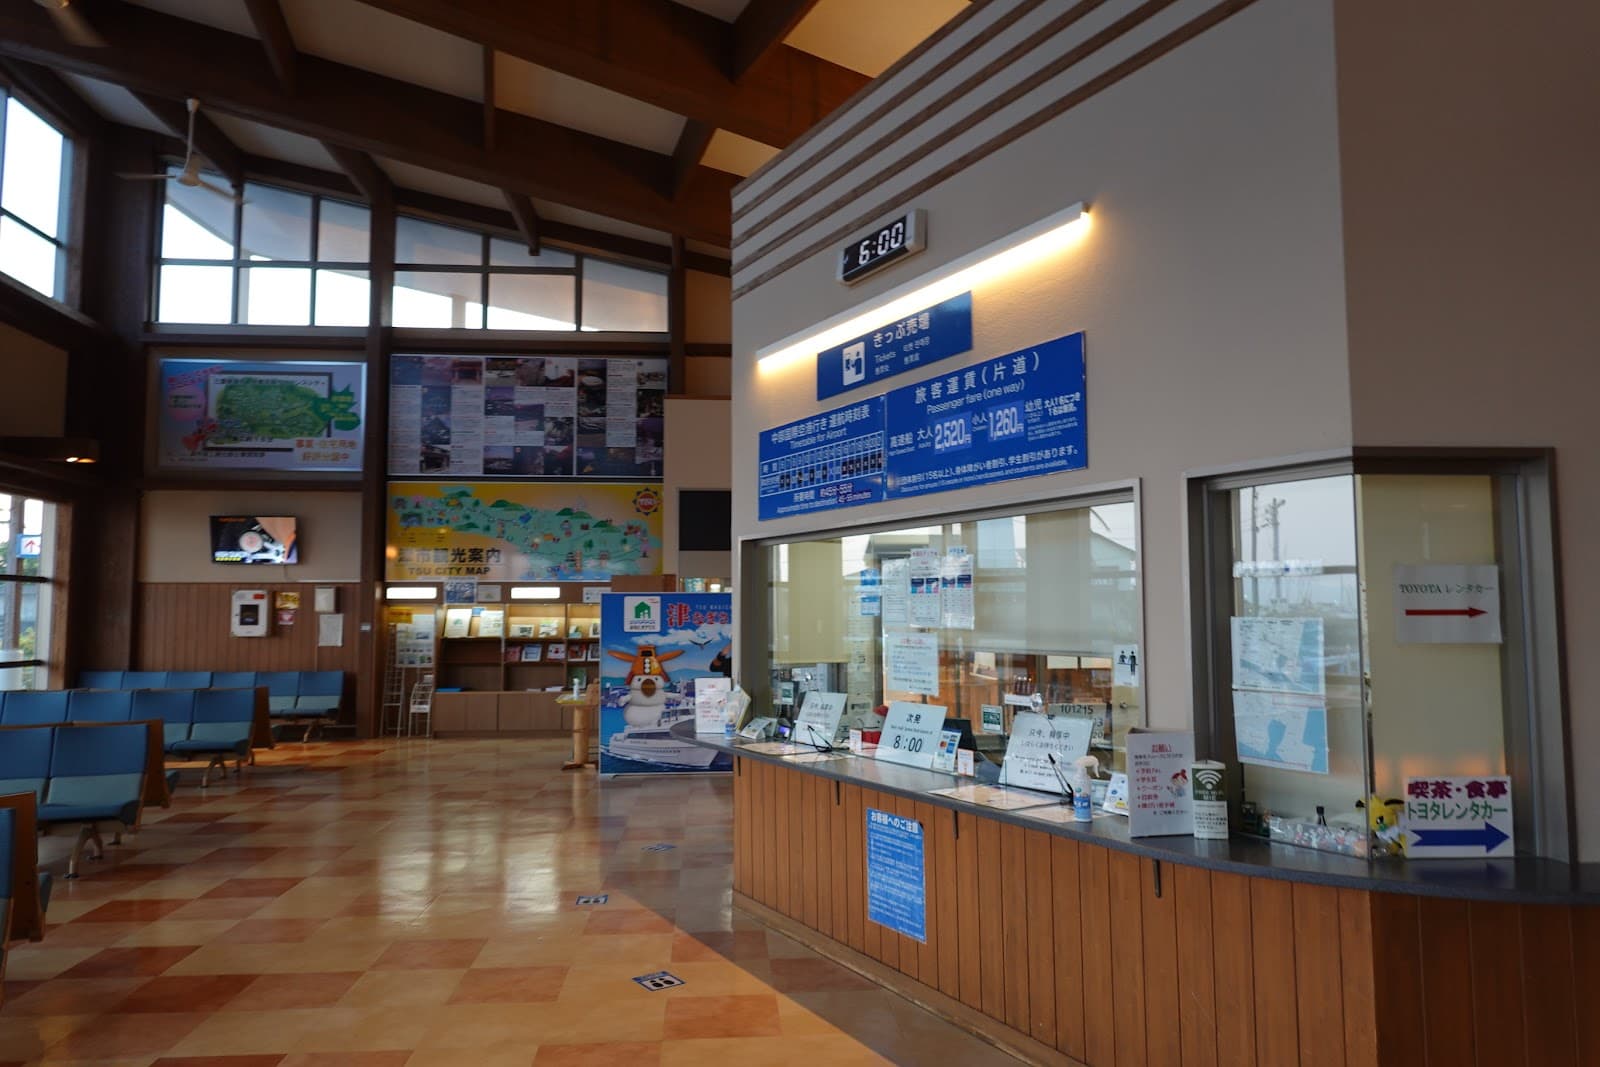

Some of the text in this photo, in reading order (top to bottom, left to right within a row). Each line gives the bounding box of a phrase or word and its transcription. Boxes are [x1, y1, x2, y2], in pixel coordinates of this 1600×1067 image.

[858, 221, 904, 265] 6:00
[927, 378, 1025, 415] Passenger fare (one way)
[971, 411, 988, 425] 小人
[917, 425, 934, 441] 大人
[407, 566, 491, 576] TSU CITY MAP
[1400, 583, 1442, 594] TOYOTA
[906, 713, 922, 725] 次発
[893, 735, 923, 753] 8:00
[1407, 780, 1509, 799] 喫茶・食事
[1406, 801, 1509, 822] トヨタレンタカー
